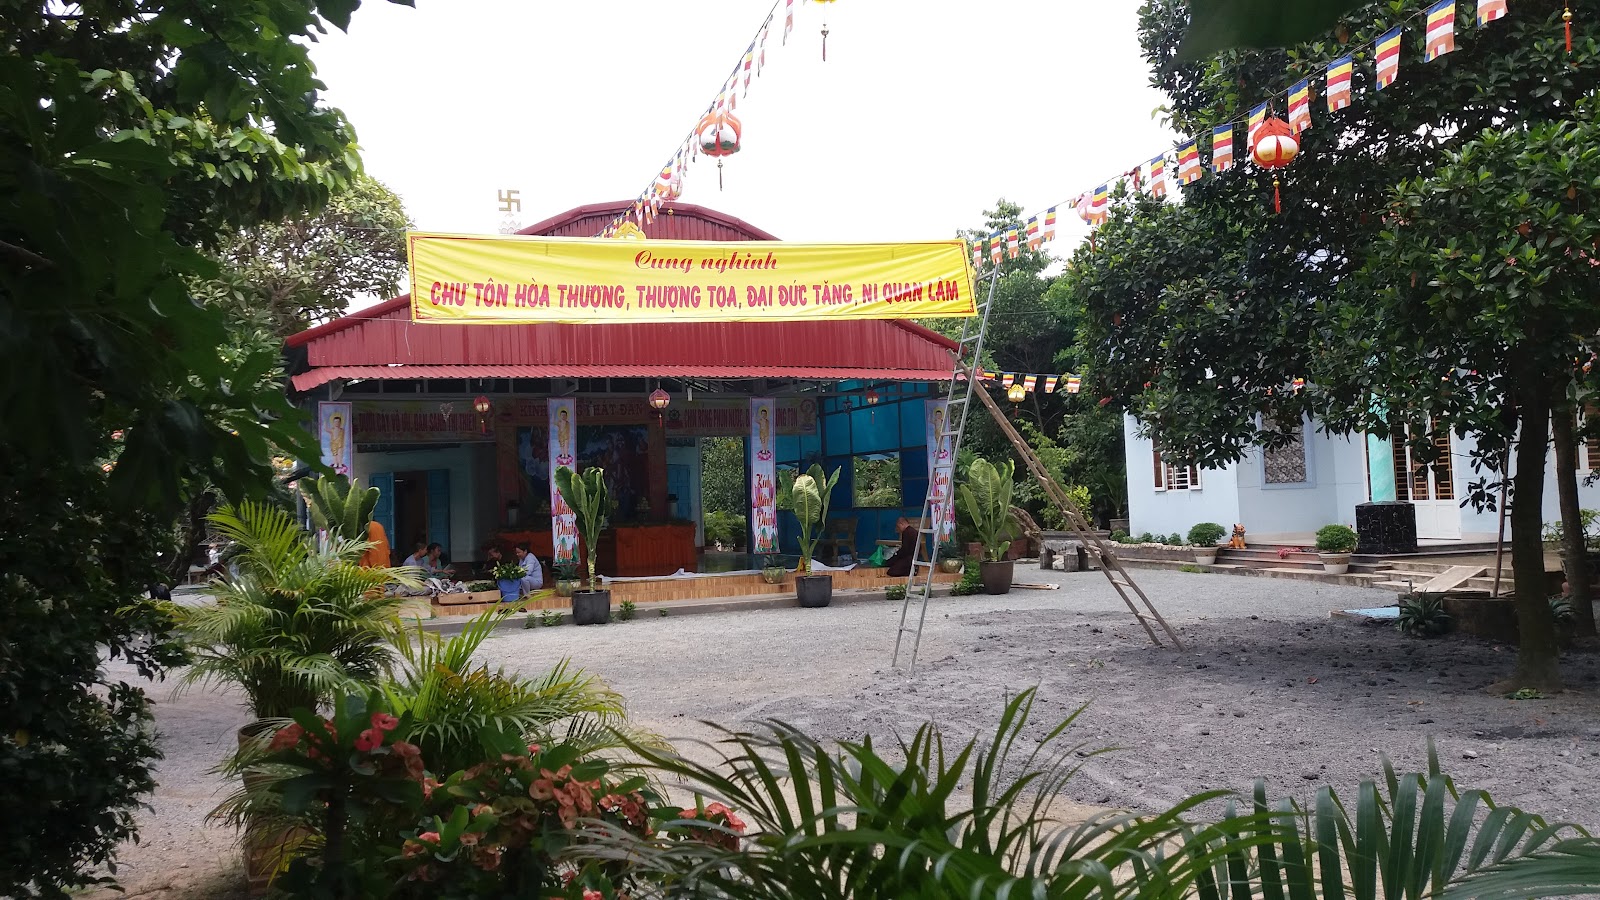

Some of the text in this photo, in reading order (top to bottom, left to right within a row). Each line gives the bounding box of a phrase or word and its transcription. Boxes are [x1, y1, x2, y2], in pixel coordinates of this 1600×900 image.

[634, 250, 778, 274] Cung nghinh
[430, 276, 960, 314] CHƯ TÔN HÒA THƯỢNG, THƯỢNG TỌA, ĐẠI ĐỨC TĂNG, NI QUAN LÂM
